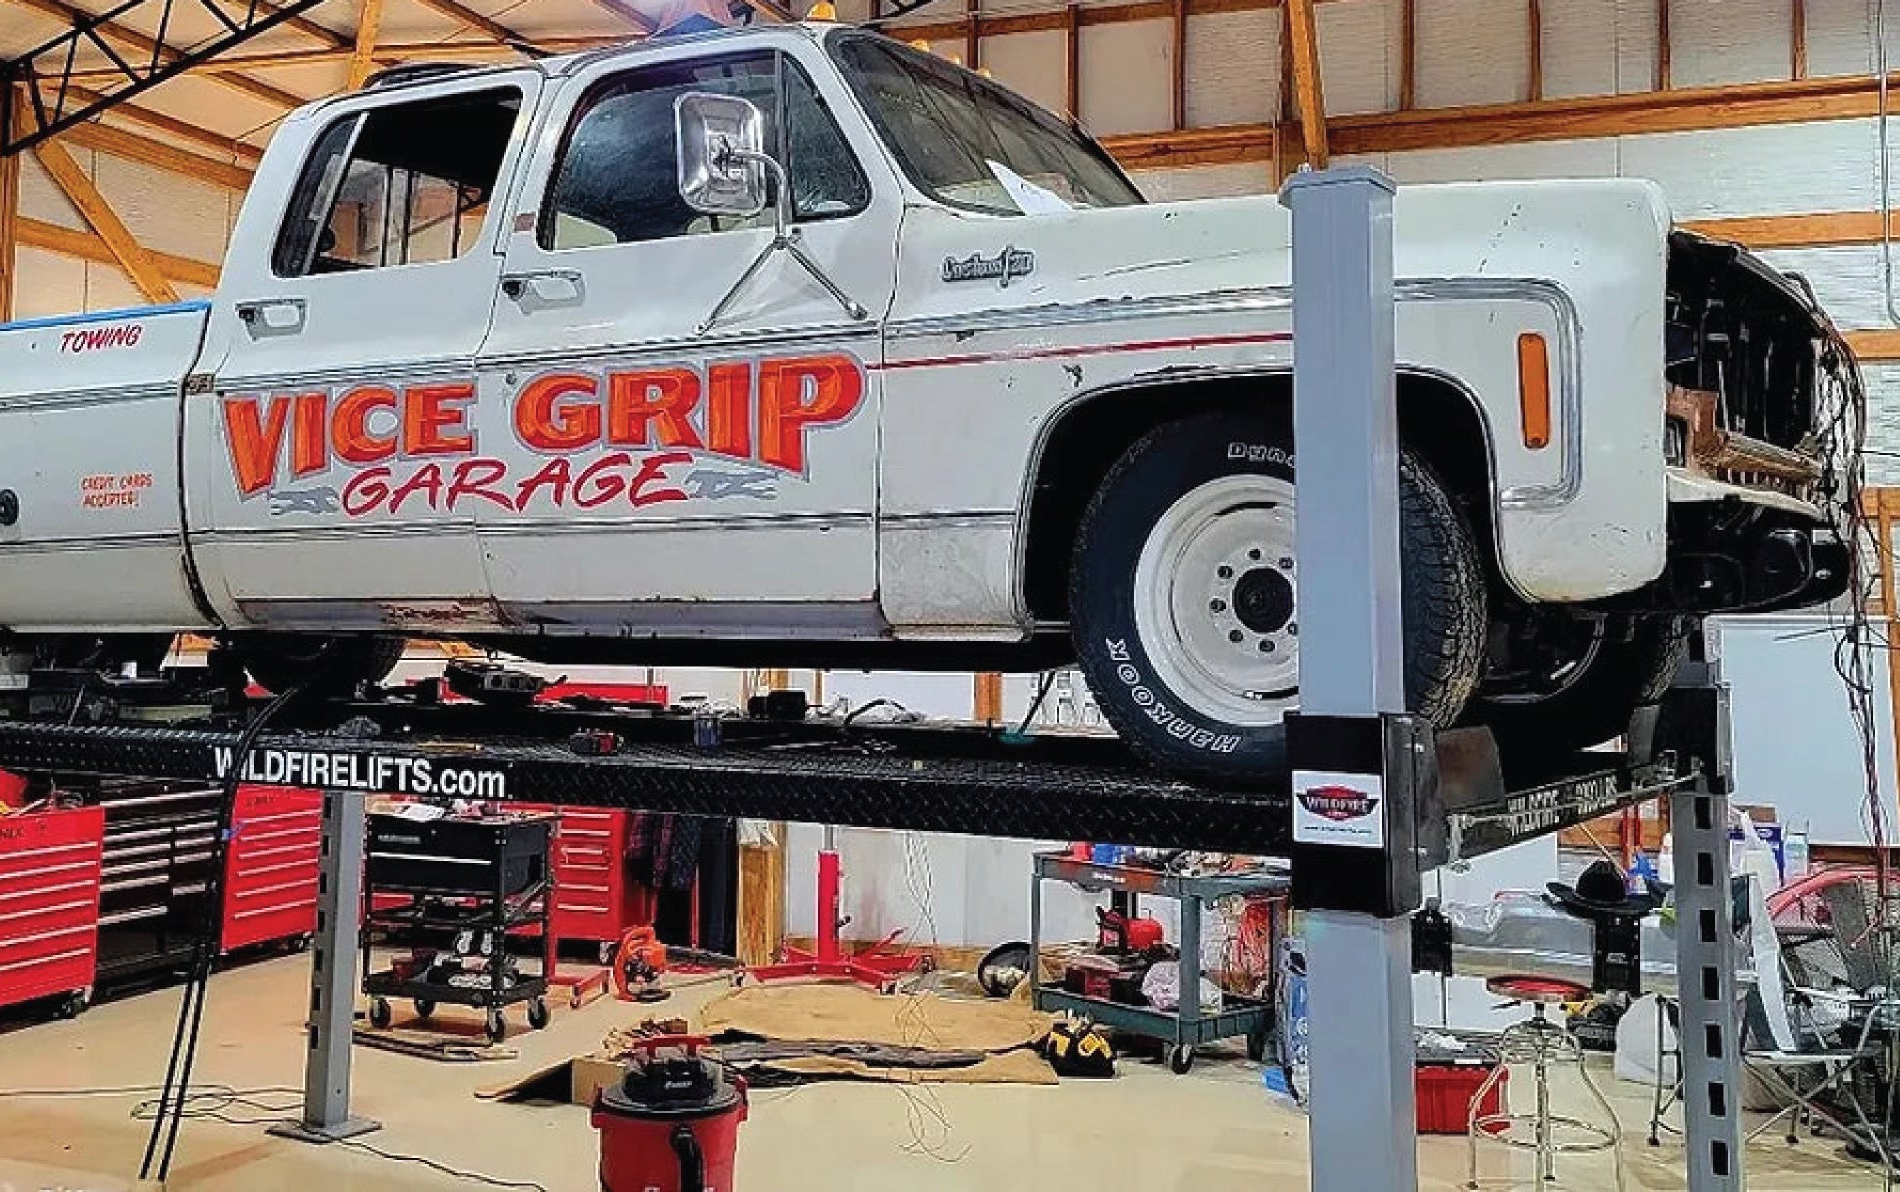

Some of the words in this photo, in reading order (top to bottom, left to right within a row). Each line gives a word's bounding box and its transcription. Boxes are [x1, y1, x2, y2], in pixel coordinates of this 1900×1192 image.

[60, 324, 142, 353] TOWING
[219, 378, 479, 498] VICE
[512, 348, 868, 482] GRIP
[341, 453, 693, 517] GARAGE
[1105, 638, 1242, 752] HANKOOK
[214, 746, 505, 798] WILDFIRELIFTS.com
